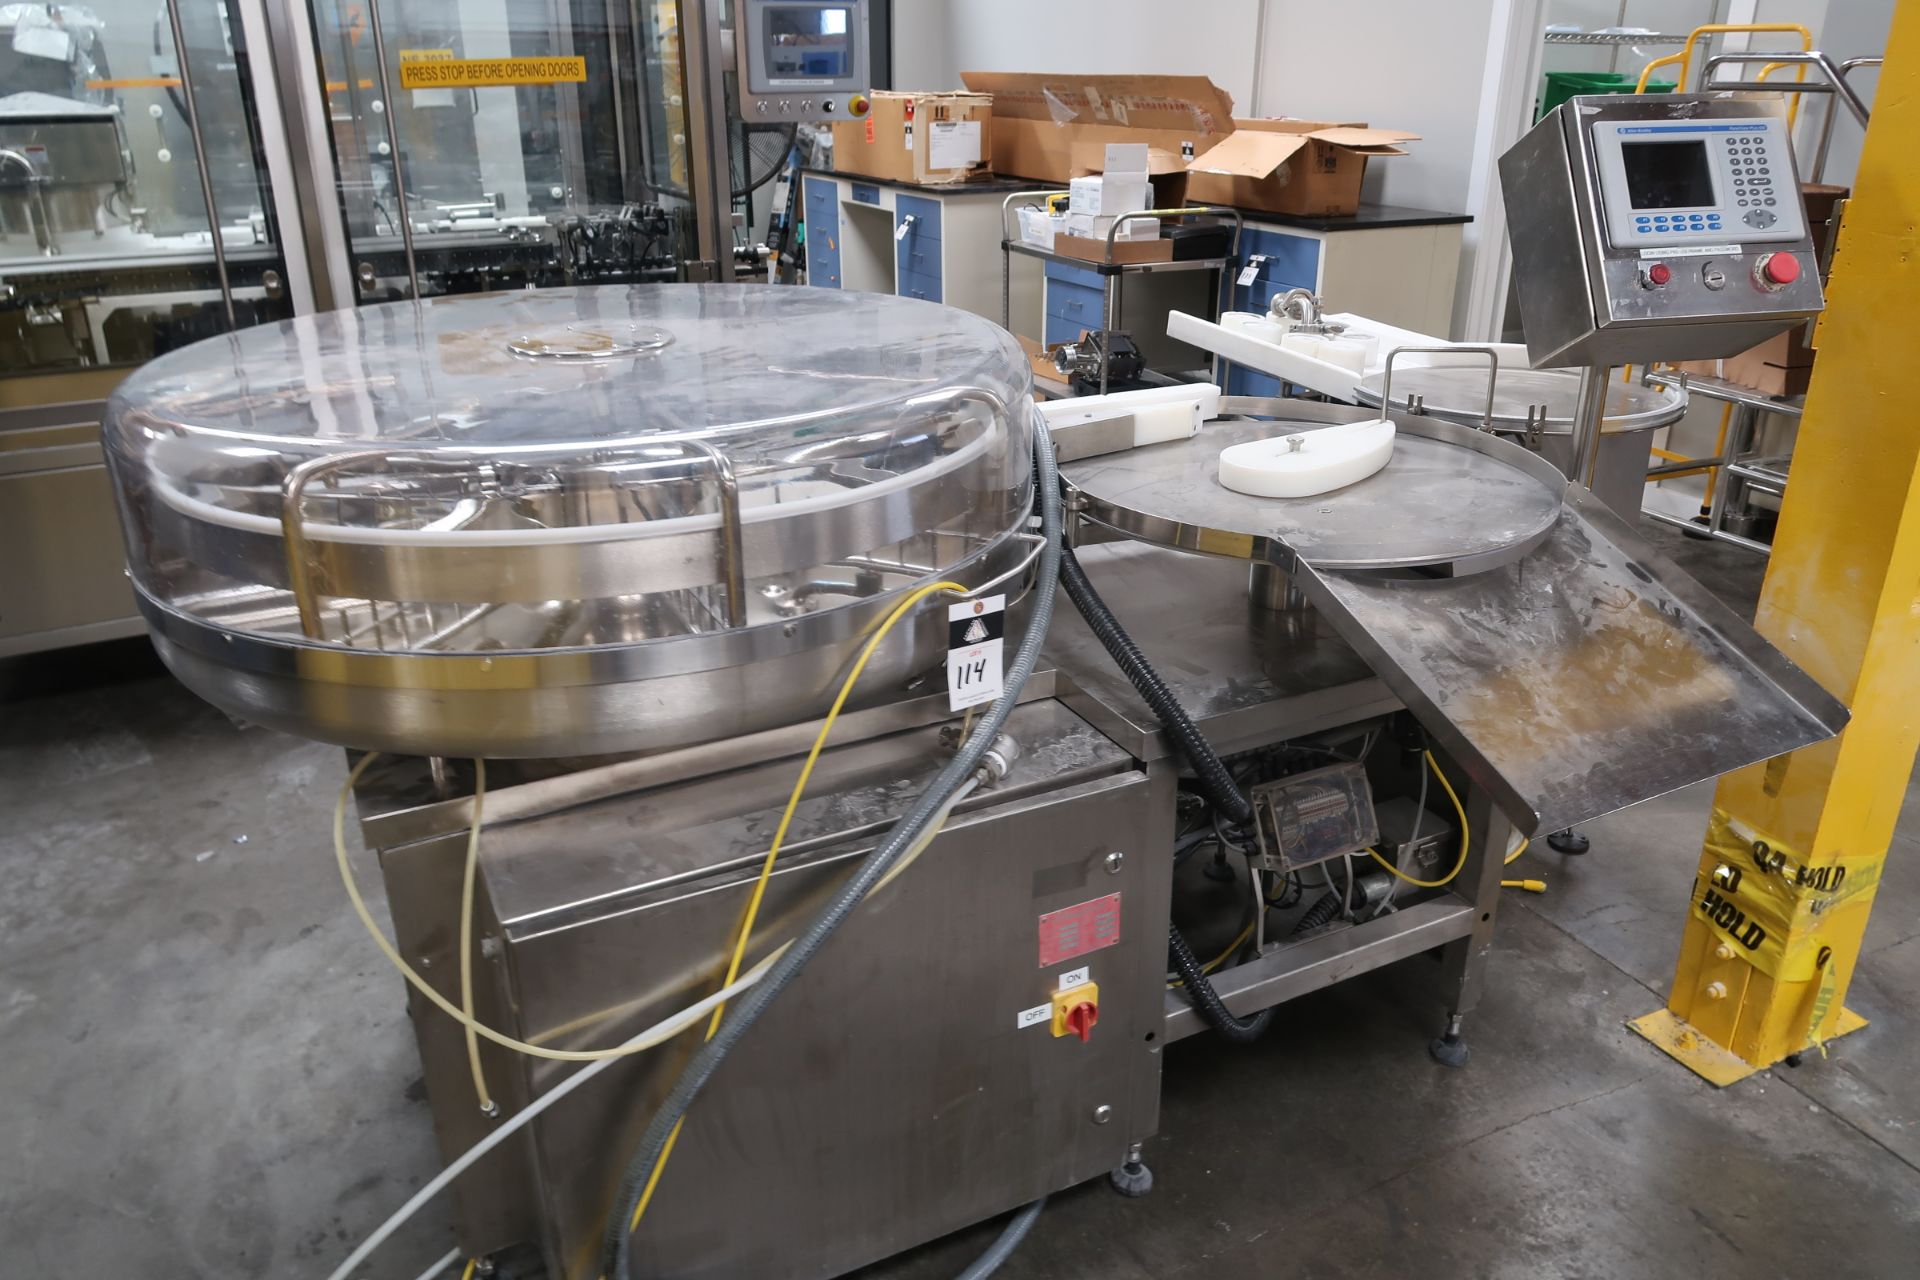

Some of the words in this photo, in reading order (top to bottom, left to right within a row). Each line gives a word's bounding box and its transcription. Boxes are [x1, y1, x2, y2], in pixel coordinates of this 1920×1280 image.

[406, 66, 438, 82] PRESS
[440, 65, 465, 81] STOP
[467, 64, 504, 80] BEFORE
[505, 62, 546, 79] OPENING
[548, 62, 580, 77] DOORS
[957, 658, 987, 690] 114
[1701, 888, 1767, 951] HOLD
[1066, 973, 1082, 984] ON
[1025, 1008, 1047, 1021] OFF
